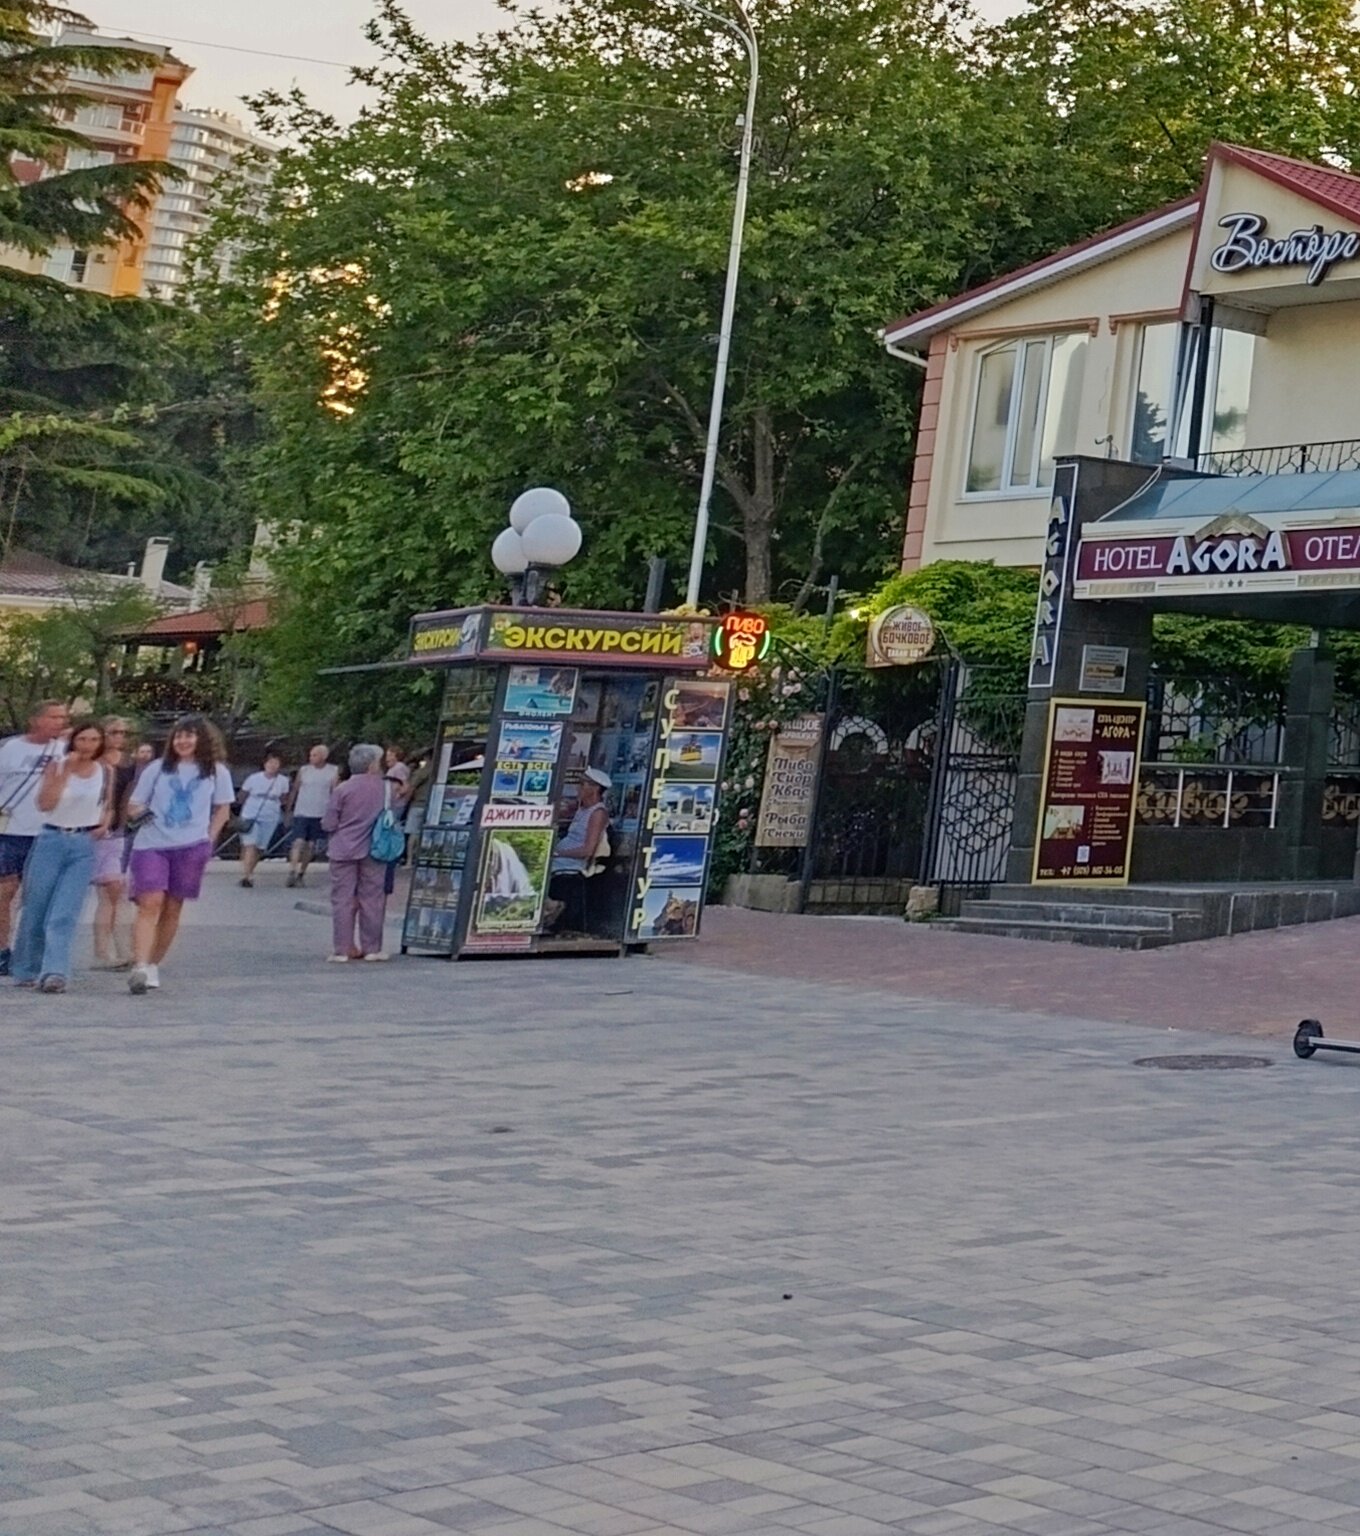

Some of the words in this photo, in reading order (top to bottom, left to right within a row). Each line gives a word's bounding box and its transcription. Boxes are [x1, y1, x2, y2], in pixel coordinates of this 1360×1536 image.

[1094, 545, 1162, 571] HOTEL
[1166, 531, 1287, 574] AGORA
[1032, 496, 1066, 665] AGORA
[727, 616, 764, 634] ПИВО
[893, 622, 921, 631] ЖИВОЕ
[504, 626, 682, 654] ЭКСКУРСИИ
[882, 632, 930, 644] БОЧКОВОЕ
[1101, 726, 1130, 738] АГОРА
[774, 758, 813, 770] Пиво
[772, 772, 811, 785] Сидр
[771, 784, 809, 796] Квас
[484, 809, 525, 823] ДЖИП
[529, 809, 551, 818] ТУР
[765, 813, 806, 824] Рыба
[764, 828, 804, 838] Снеки
